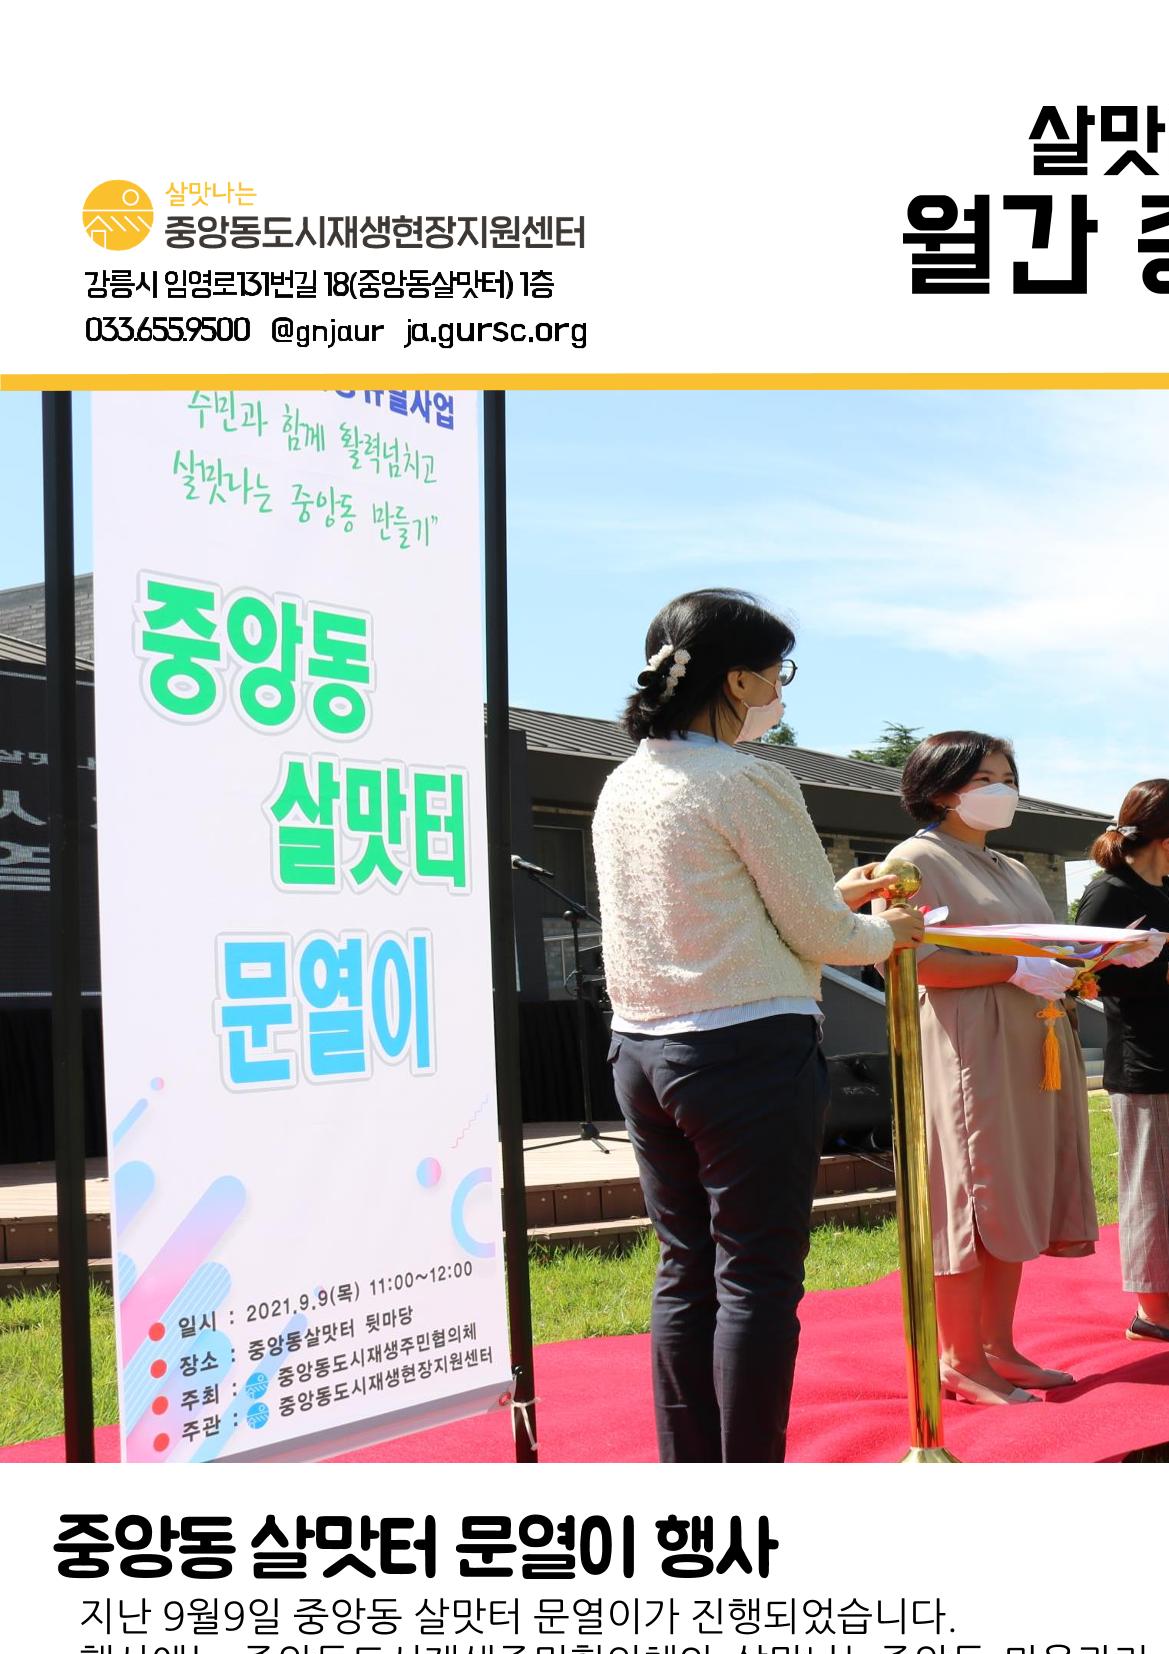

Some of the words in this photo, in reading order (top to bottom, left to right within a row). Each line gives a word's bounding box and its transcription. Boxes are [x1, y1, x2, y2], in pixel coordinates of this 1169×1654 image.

[165, 215, 584, 248] 중앙동도시재생현장지원센터
[166, 182, 257, 207] 살맛나는
[85, 270, 157, 298] 강릉시
[165, 270, 316, 298] 임영로131번길
[324, 270, 513, 299] 18(중앙동살맛터)
[520, 270, 554, 298] 1층
[903, 195, 1098, 294] 월간
[86, 317, 250, 341] 033.655.9500
[272, 317, 384, 348] @gnjaur
[404, 319, 586, 348] ja.gursc.org
[282, 404, 325, 453] 함께
[339, 422, 438, 484] 활력넘치고
[173, 449, 273, 513] 살맛나는
[291, 483, 358, 533] 중앙동
[140, 578, 373, 736] 중앙동
[268, 759, 469, 890] 살맛터
[219, 935, 432, 1086] 문열이
[178, 1308, 218, 1340] 일시
[246, 1280, 361, 1324] 2021.9.9(목)
[368, 1260, 474, 1298] 11:00~12:00
[179, 1350, 220, 1379] 장소
[247, 1322, 356, 1362] 중앙동살맛터
[365, 1304, 415, 1334] 뒷마당
[181, 1383, 220, 1412] 주최
[277, 1321, 478, 1389] 중앙동도시재생주민협의체
[181, 1415, 222, 1444] 주관
[278, 1345, 494, 1419] 중앙동도시재생현장지원센터
[53, 1514, 236, 1579] 중앙동
[251, 1515, 436, 1579] 살맛터
[456, 1514, 634, 1579] 문열이
[655, 1514, 779, 1578] 행사
[81, 1598, 151, 1634] 지난
[164, 1598, 278, 1634] 9월9일
[294, 1598, 402, 1635] 중앙동
[415, 1598, 518, 1634] 살맛터
[534, 1598, 679, 1634] 문열이가
[693, 1598, 954, 1634] 진행되었습니다.
